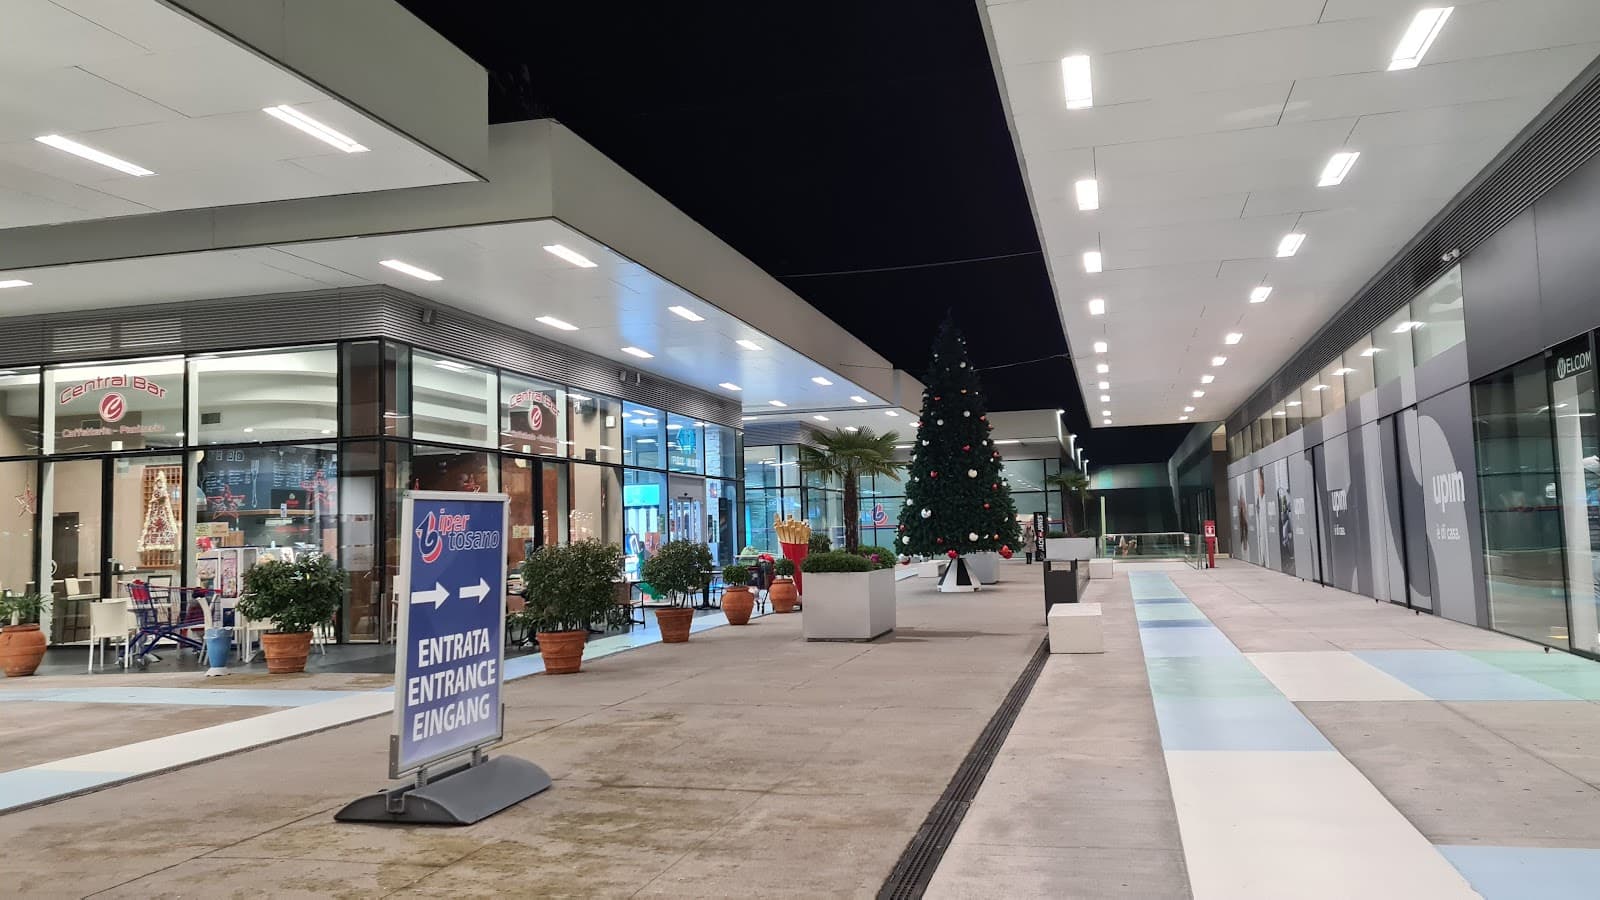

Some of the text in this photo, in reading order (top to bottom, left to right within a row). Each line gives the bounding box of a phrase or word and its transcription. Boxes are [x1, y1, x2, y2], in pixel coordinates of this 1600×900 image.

[60, 374, 166, 405] Central Bar
[510, 389, 560, 416] Central Bar
[1432, 471, 1465, 513] upim
[439, 508, 471, 536] iper
[448, 530, 500, 551] tosano
[418, 627, 490, 669] ENTRATA
[408, 658, 497, 707] ENTRANCE
[412, 693, 490, 742] EINGANG
